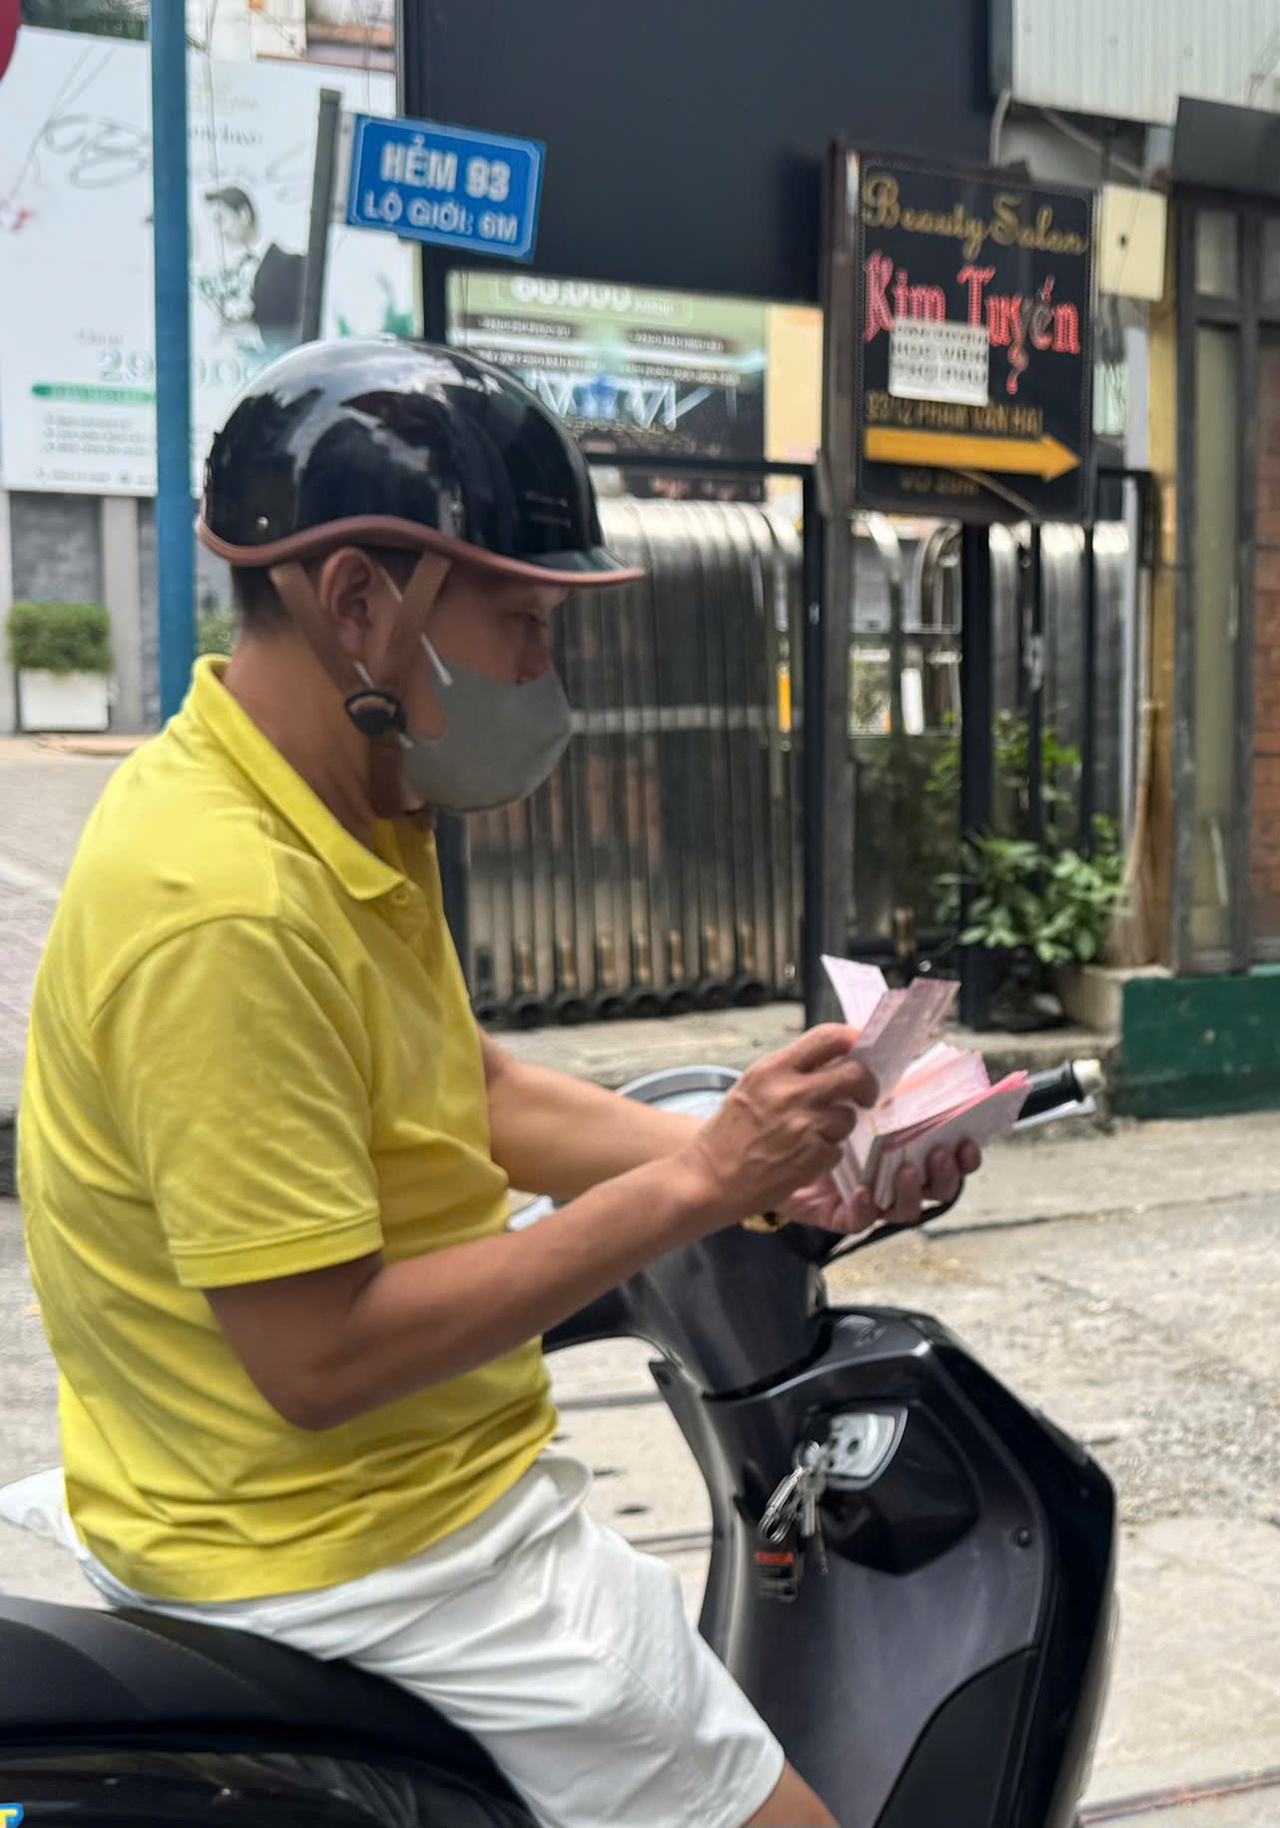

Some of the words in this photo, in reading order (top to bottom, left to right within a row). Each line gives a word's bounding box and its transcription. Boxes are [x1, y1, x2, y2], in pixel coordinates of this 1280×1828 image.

[380, 133, 458, 192] HẺM
[465, 156, 511, 202] 93
[478, 211, 519, 244] 6M
[862, 174, 989, 261] Beauty
[988, 191, 1086, 255] Salon
[863, 250, 946, 342] Kim
